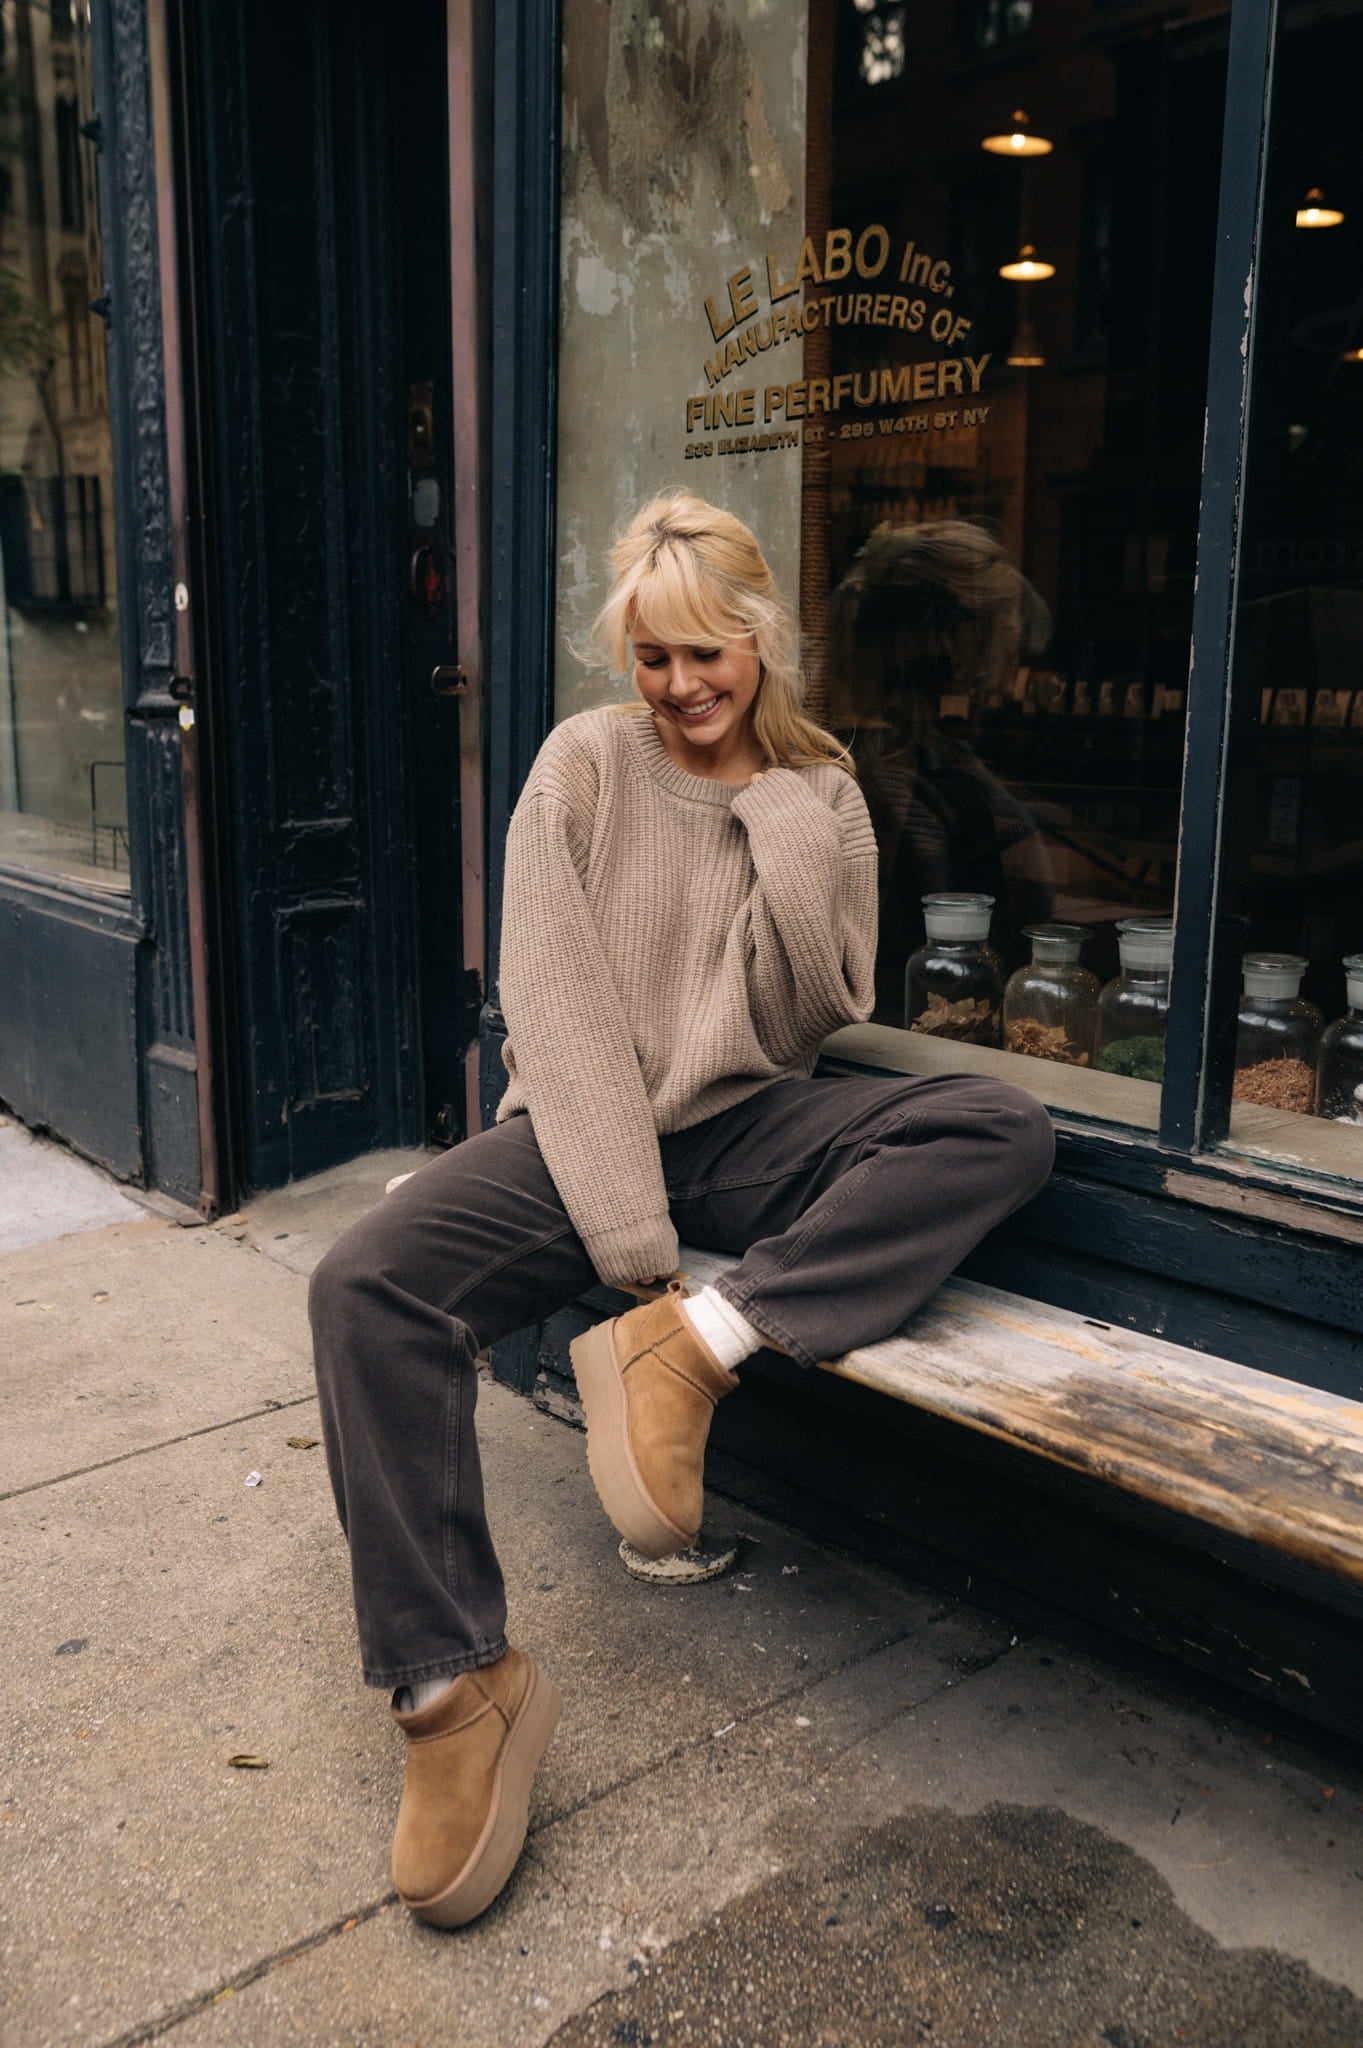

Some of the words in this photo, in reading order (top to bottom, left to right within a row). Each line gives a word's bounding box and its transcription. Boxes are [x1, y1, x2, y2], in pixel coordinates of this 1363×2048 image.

[704, 266, 758, 342] LE
[766, 224, 890, 304] LABO
[704, 293, 926, 387] MANUFACTURERS
[930, 308, 972, 347] OF
[686, 388, 755, 432] FINE
[764, 354, 992, 423] PERFUMERY
[879, 414, 929, 435] W4TH
[935, 410, 958, 430] ST
[963, 407, 992, 428] NY
